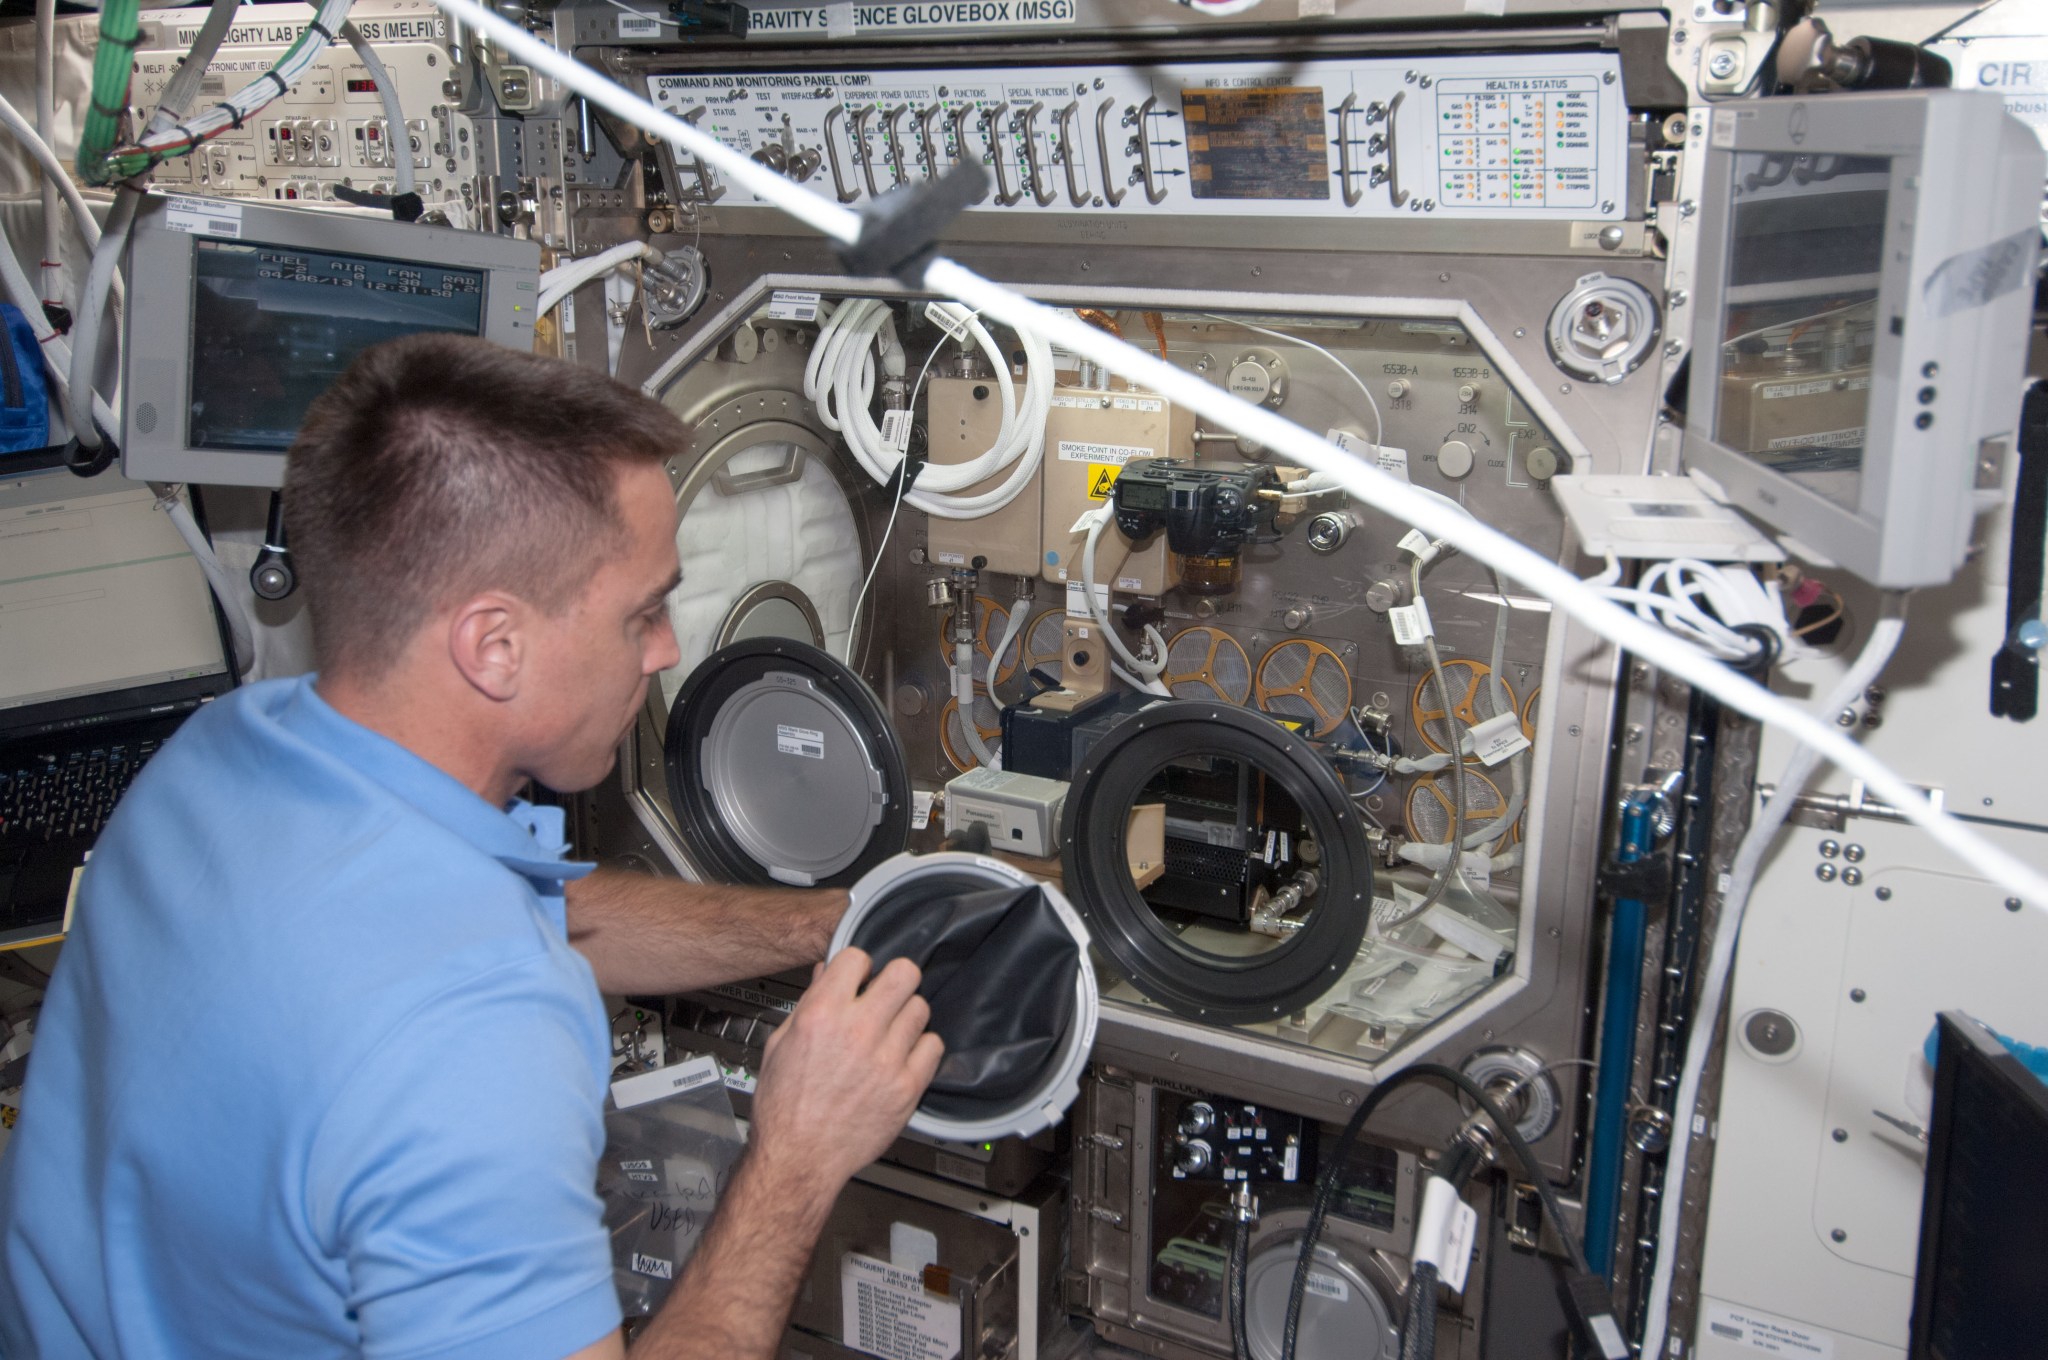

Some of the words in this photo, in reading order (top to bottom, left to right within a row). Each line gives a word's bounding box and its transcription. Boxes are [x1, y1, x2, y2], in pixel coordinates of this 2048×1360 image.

[818, 6, 898, 27] SENCE
[903, 2, 1009, 23] GLOVEBOX
[1016, 0, 1075, 21] (MSG)
[268, 27, 293, 42] LAB
[383, 22, 434, 40] (MELFI)
[437, 23, 446, 37] 3
[143, 65, 165, 74] MELFI
[240, 61, 255, 71] UNIT
[1978, 63, 2032, 87] CIR
[659, 77, 710, 89] COMMAND
[713, 77, 734, 88] AND
[736, 76, 801, 88] MONITORING
[804, 75, 839, 87] PANEL
[840, 74, 871, 86] (CMP)
[1205, 79, 1221, 88] INFO
[1232, 78, 1265, 87] CONTROL
[1266, 77, 1295, 86] CENTRE
[1486, 80, 1521, 90] HEALTH
[1522, 80, 1529, 89] &
[1531, 79, 1568, 89] STATUS
[845, 91, 878, 100] EXPERIMENT
[880, 90, 902, 99] POWER
[904, 89, 930, 99] OUTLETS
[954, 88, 986, 98] FUNCTIONS
[1008, 88, 1032, 97] SPECIAL
[1035, 87, 1069, 96] FUNCTIONS
[713, 108, 737, 116] STATUS
[260, 254, 307, 267] FUEL
[331, 261, 365, 273] AIR
[388, 268, 422, 280] FAN
[259, 269, 353, 288] 04/06/13
[366, 281, 453, 299] 12:31:58
[400, 277, 421, 287] 38
[443, 275, 476, 286] RAD
[1457, 404, 1478, 416] J314
[1457, 422, 1477, 434] GN2
[1517, 429, 1536, 440] EXP
[1061, 443, 1087, 452] SMOKE
[1087, 445, 1108, 454] POINT
[1070, 451, 1115, 462] EXPERIMENT
[1487, 459, 1506, 468] CLOSE
[965, 809, 995, 820] Panasonic
[744, 990, 796, 1012] DISTRIBUT
[650, 1200, 696, 1237] USED
[851, 1258, 886, 1275] FREQUENT
[887, 1269, 901, 1279] USE
